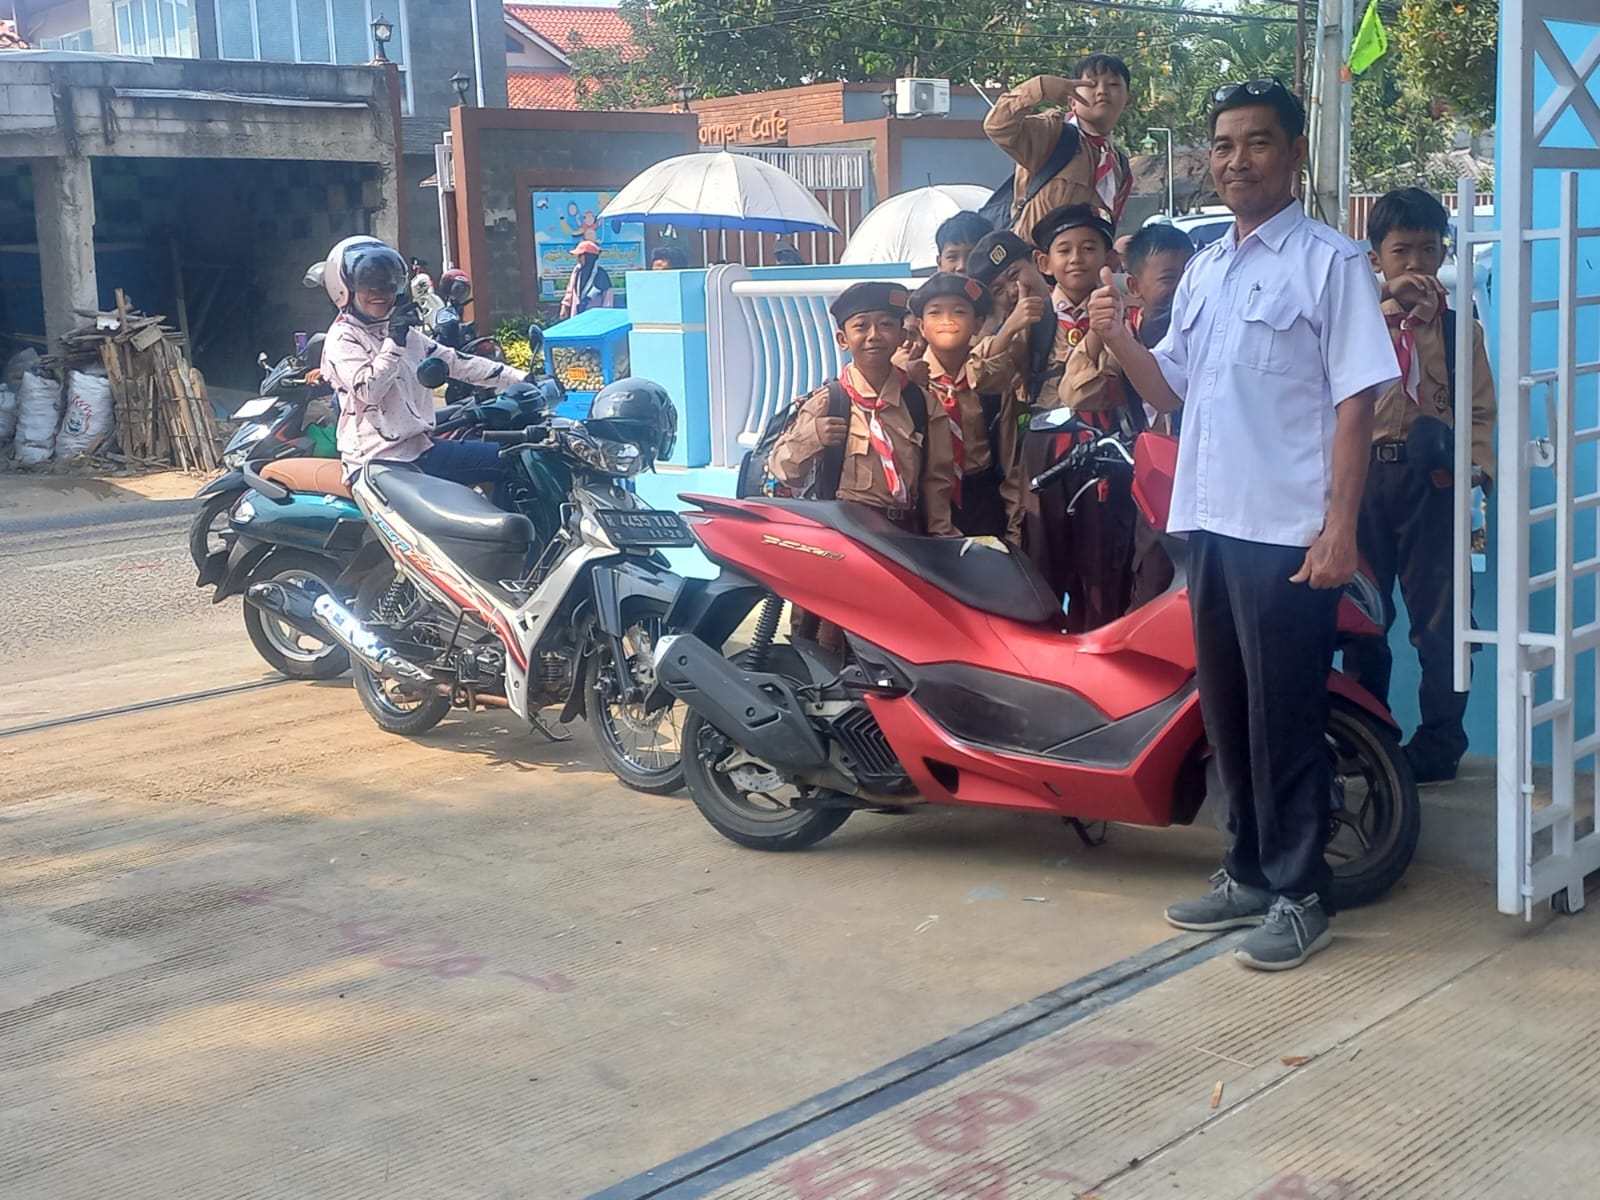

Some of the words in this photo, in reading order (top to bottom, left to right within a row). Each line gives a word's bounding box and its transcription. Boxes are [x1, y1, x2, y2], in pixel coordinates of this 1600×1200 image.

[698, 122, 742, 144] orner
[749, 109, 788, 140] Cafe
[620, 514, 652, 528] 4455
